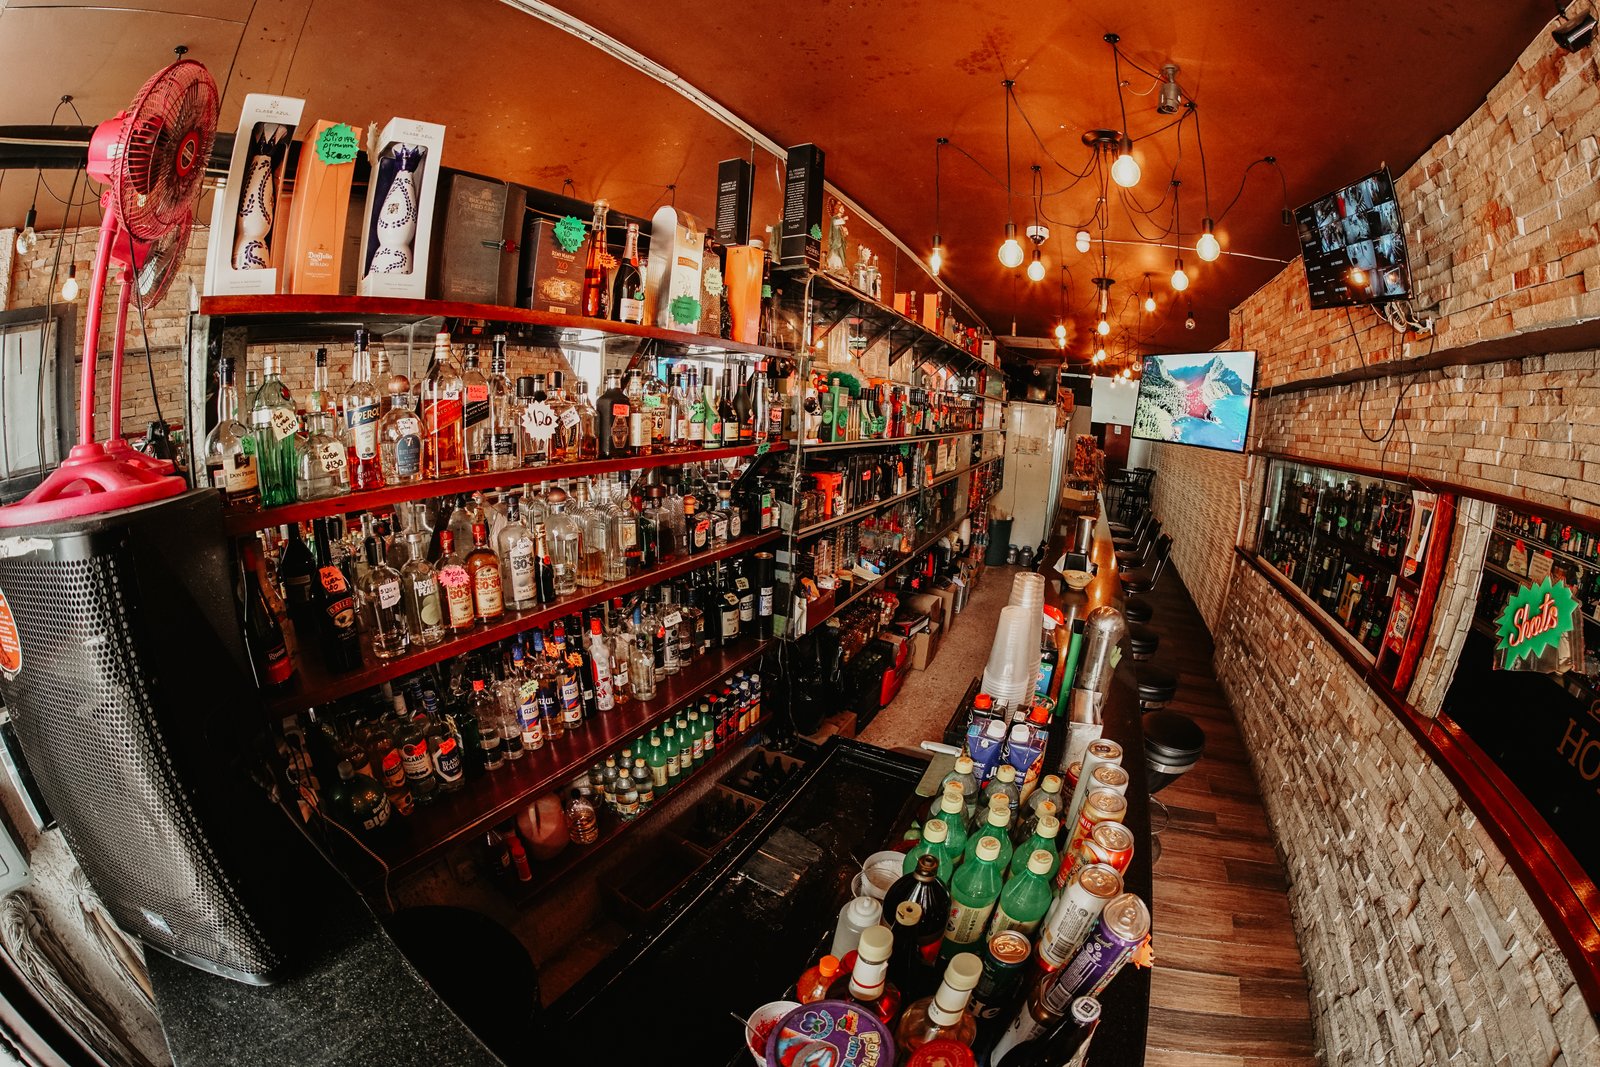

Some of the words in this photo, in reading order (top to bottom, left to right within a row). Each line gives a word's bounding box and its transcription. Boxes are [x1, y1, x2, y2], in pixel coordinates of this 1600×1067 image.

[351, 407, 380, 425] APEROL
[406, 437, 413, 447] 7
[325, 460, 344, 471] $130
[1508, 593, 1558, 647] Shots
[524, 705, 538, 714] AZUL
